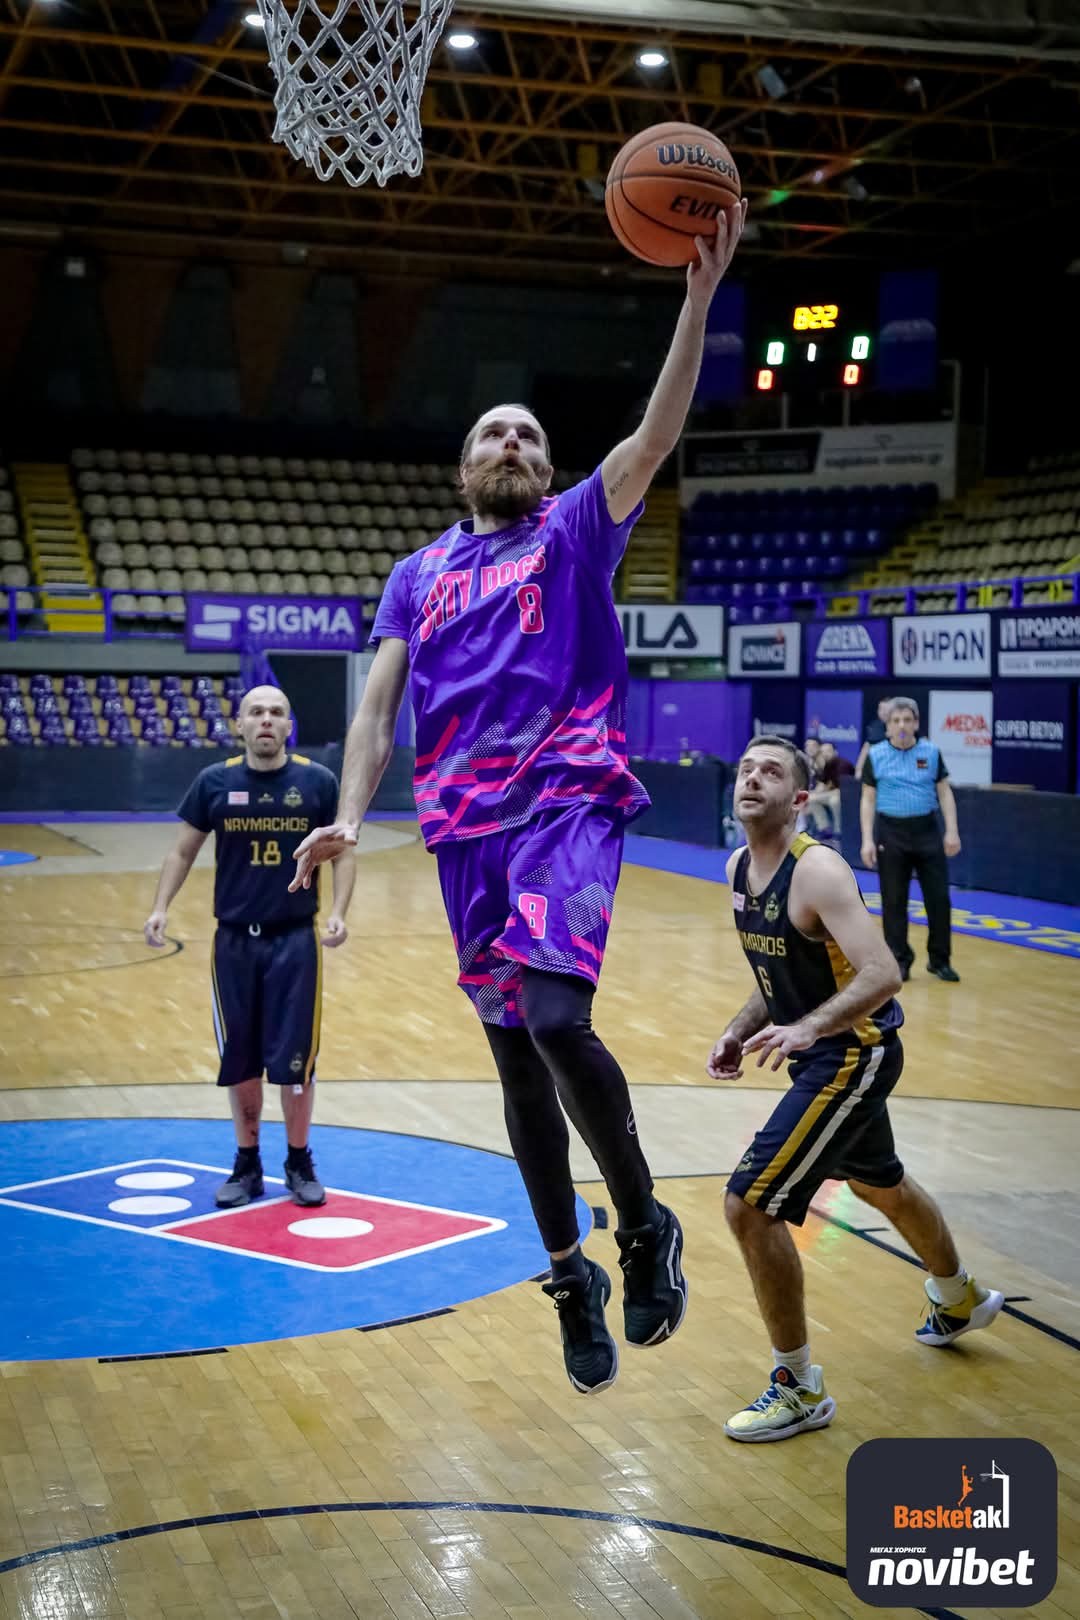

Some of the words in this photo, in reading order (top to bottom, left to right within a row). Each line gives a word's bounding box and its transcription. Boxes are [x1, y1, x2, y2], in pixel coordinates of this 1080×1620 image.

[656, 143, 738, 184] Wilson
[767, 341, 784, 365] 0
[807, 342, 816, 362] 1
[851, 335, 869, 359] 0
[758, 369, 772, 389] 0
[844, 364, 858, 384] 0
[481, 545, 546, 599] DOGS
[247, 604, 355, 634] SIGMA
[516, 583, 545, 634] 8
[622, 611, 698, 648] ILA
[995, 720, 1028, 738] SUPER
[224, 818, 309, 832] NAVMACHOS
[250, 840, 281, 865] 18
[519, 893, 547, 939] 8
[757, 965, 773, 998] 6
